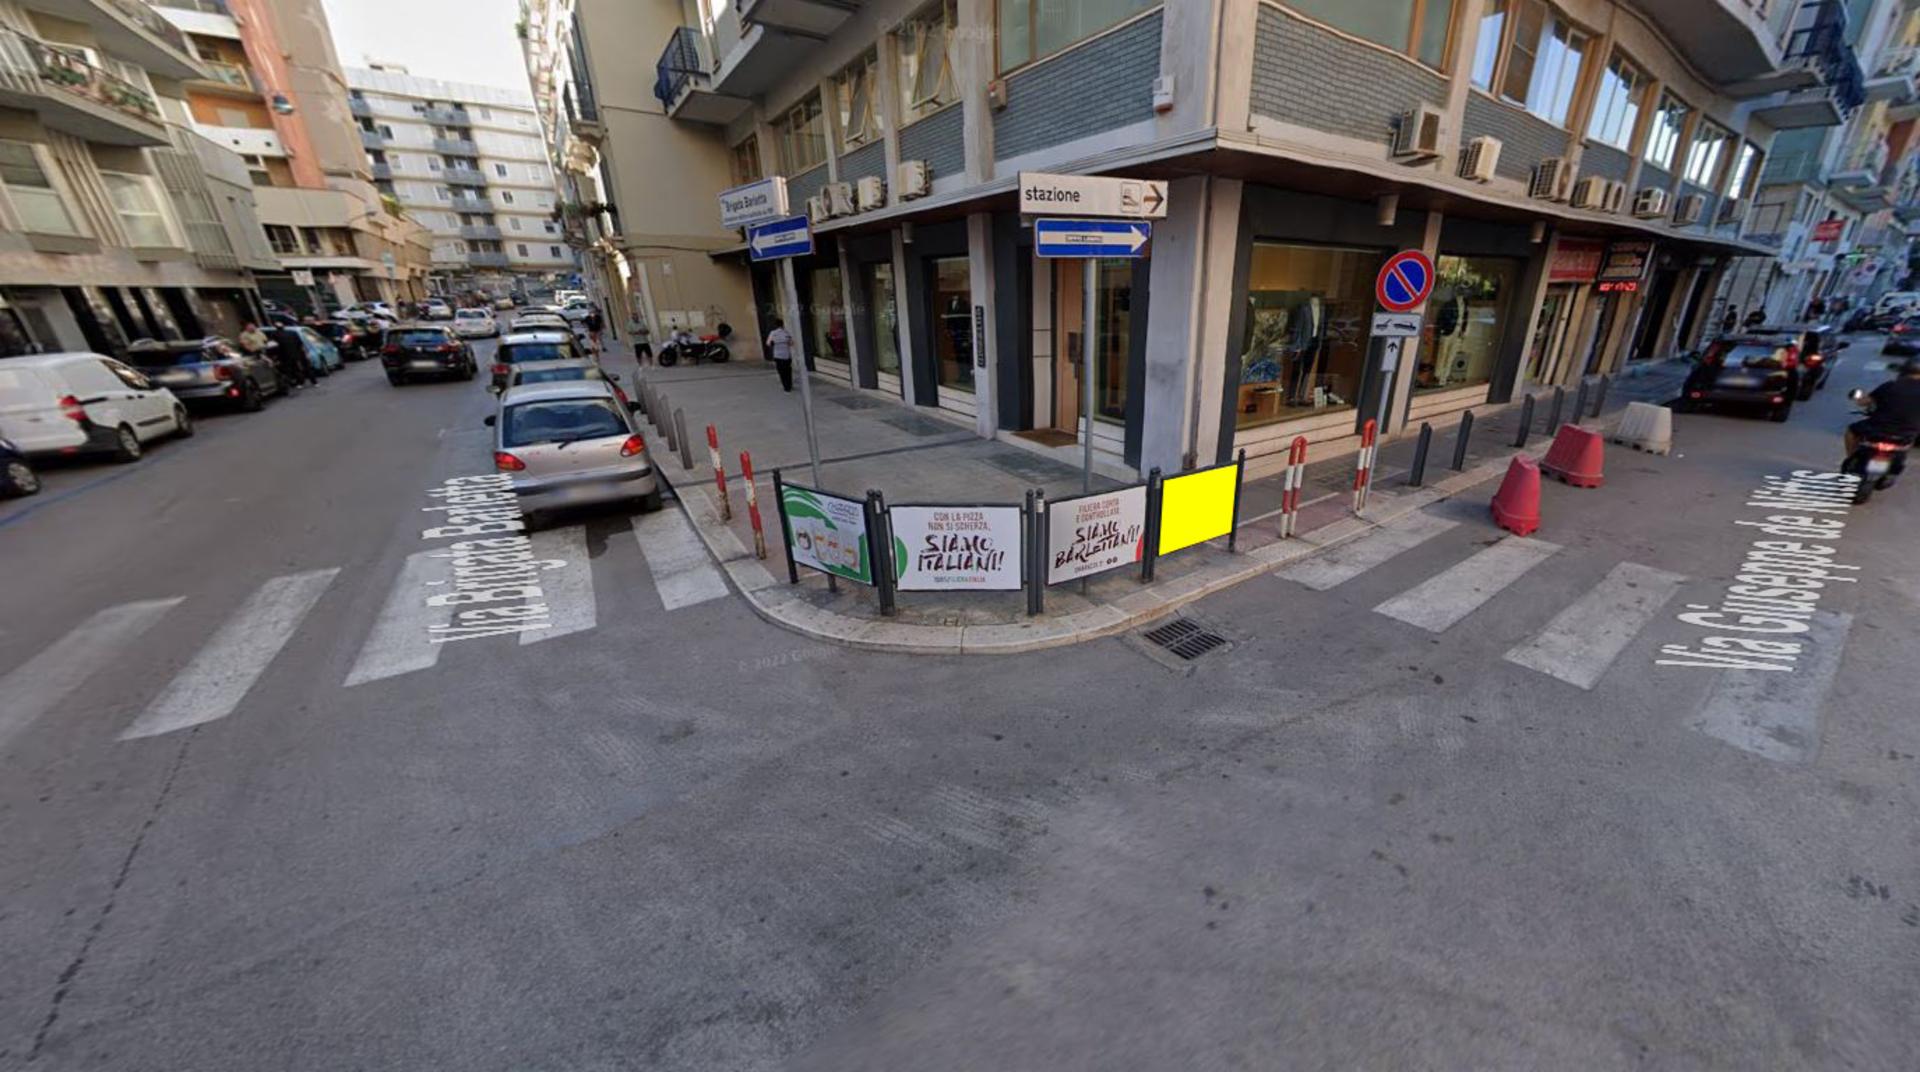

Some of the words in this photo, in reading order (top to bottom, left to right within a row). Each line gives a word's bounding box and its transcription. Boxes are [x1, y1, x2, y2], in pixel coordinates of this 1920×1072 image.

[1025, 185, 1080, 202] stazione
[933, 512, 949, 521] CON
[951, 512, 961, 521] LA
[928, 522, 944, 531] NON
[946, 522, 953, 531] SI
[1072, 520, 1120, 545] SIAMO
[921, 533, 994, 555] SIAMO
[918, 549, 1005, 572] ITALIANI!
